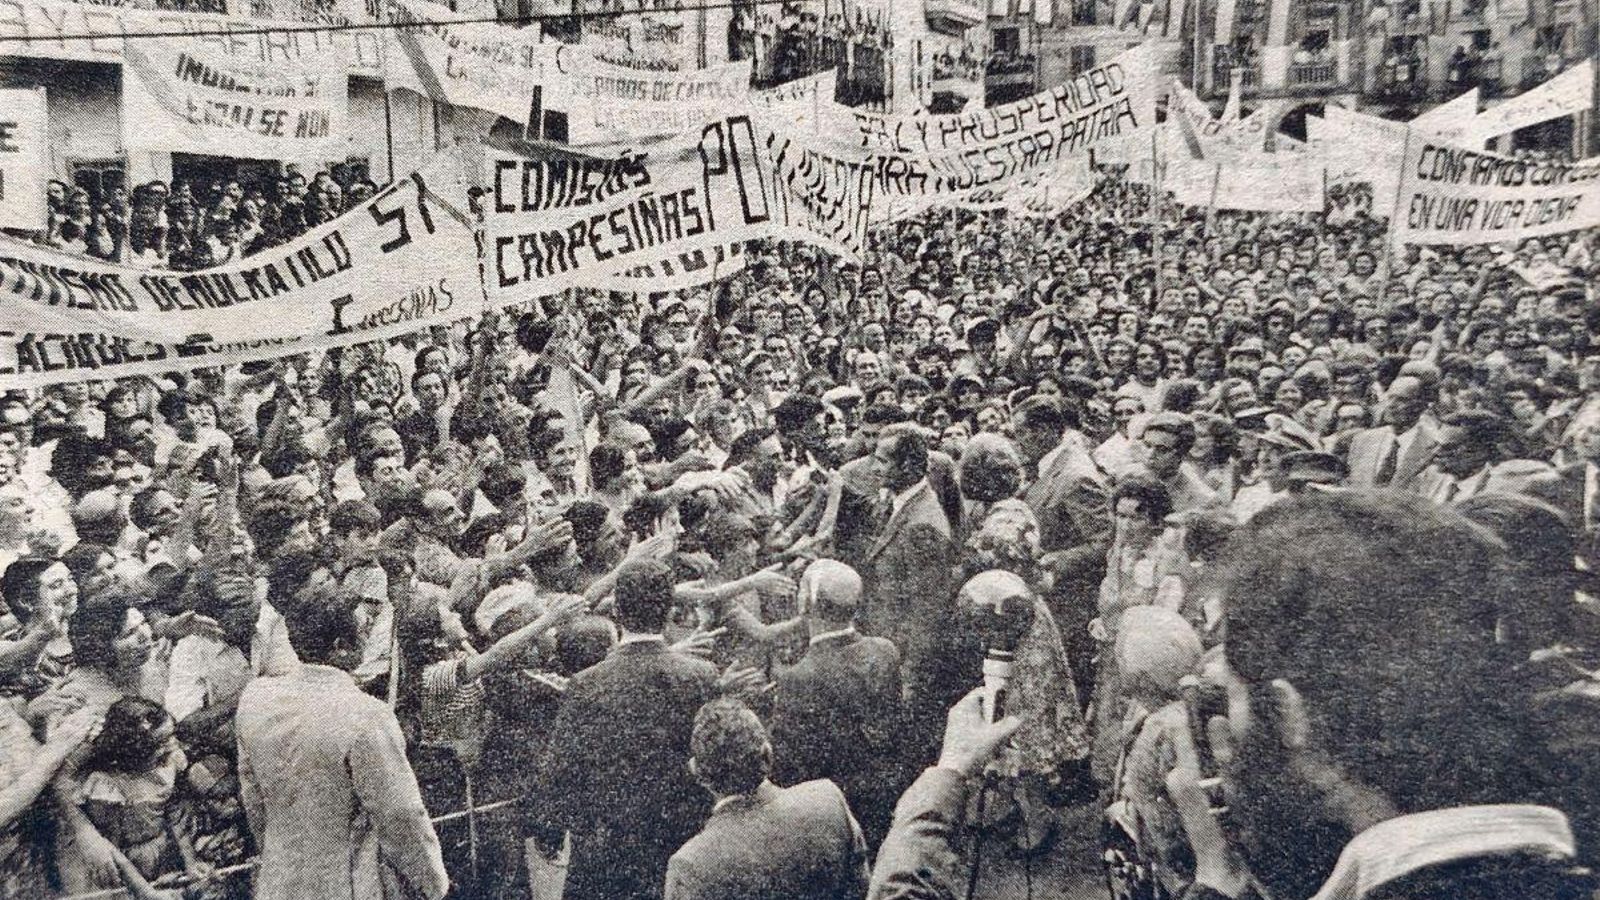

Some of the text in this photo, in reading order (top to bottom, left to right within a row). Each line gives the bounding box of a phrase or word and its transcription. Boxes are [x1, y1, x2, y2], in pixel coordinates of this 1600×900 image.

[1056, 97, 1138, 160] PATRIA
[1408, 193, 1434, 230] EN
[1434, 196, 1479, 231] UNA
